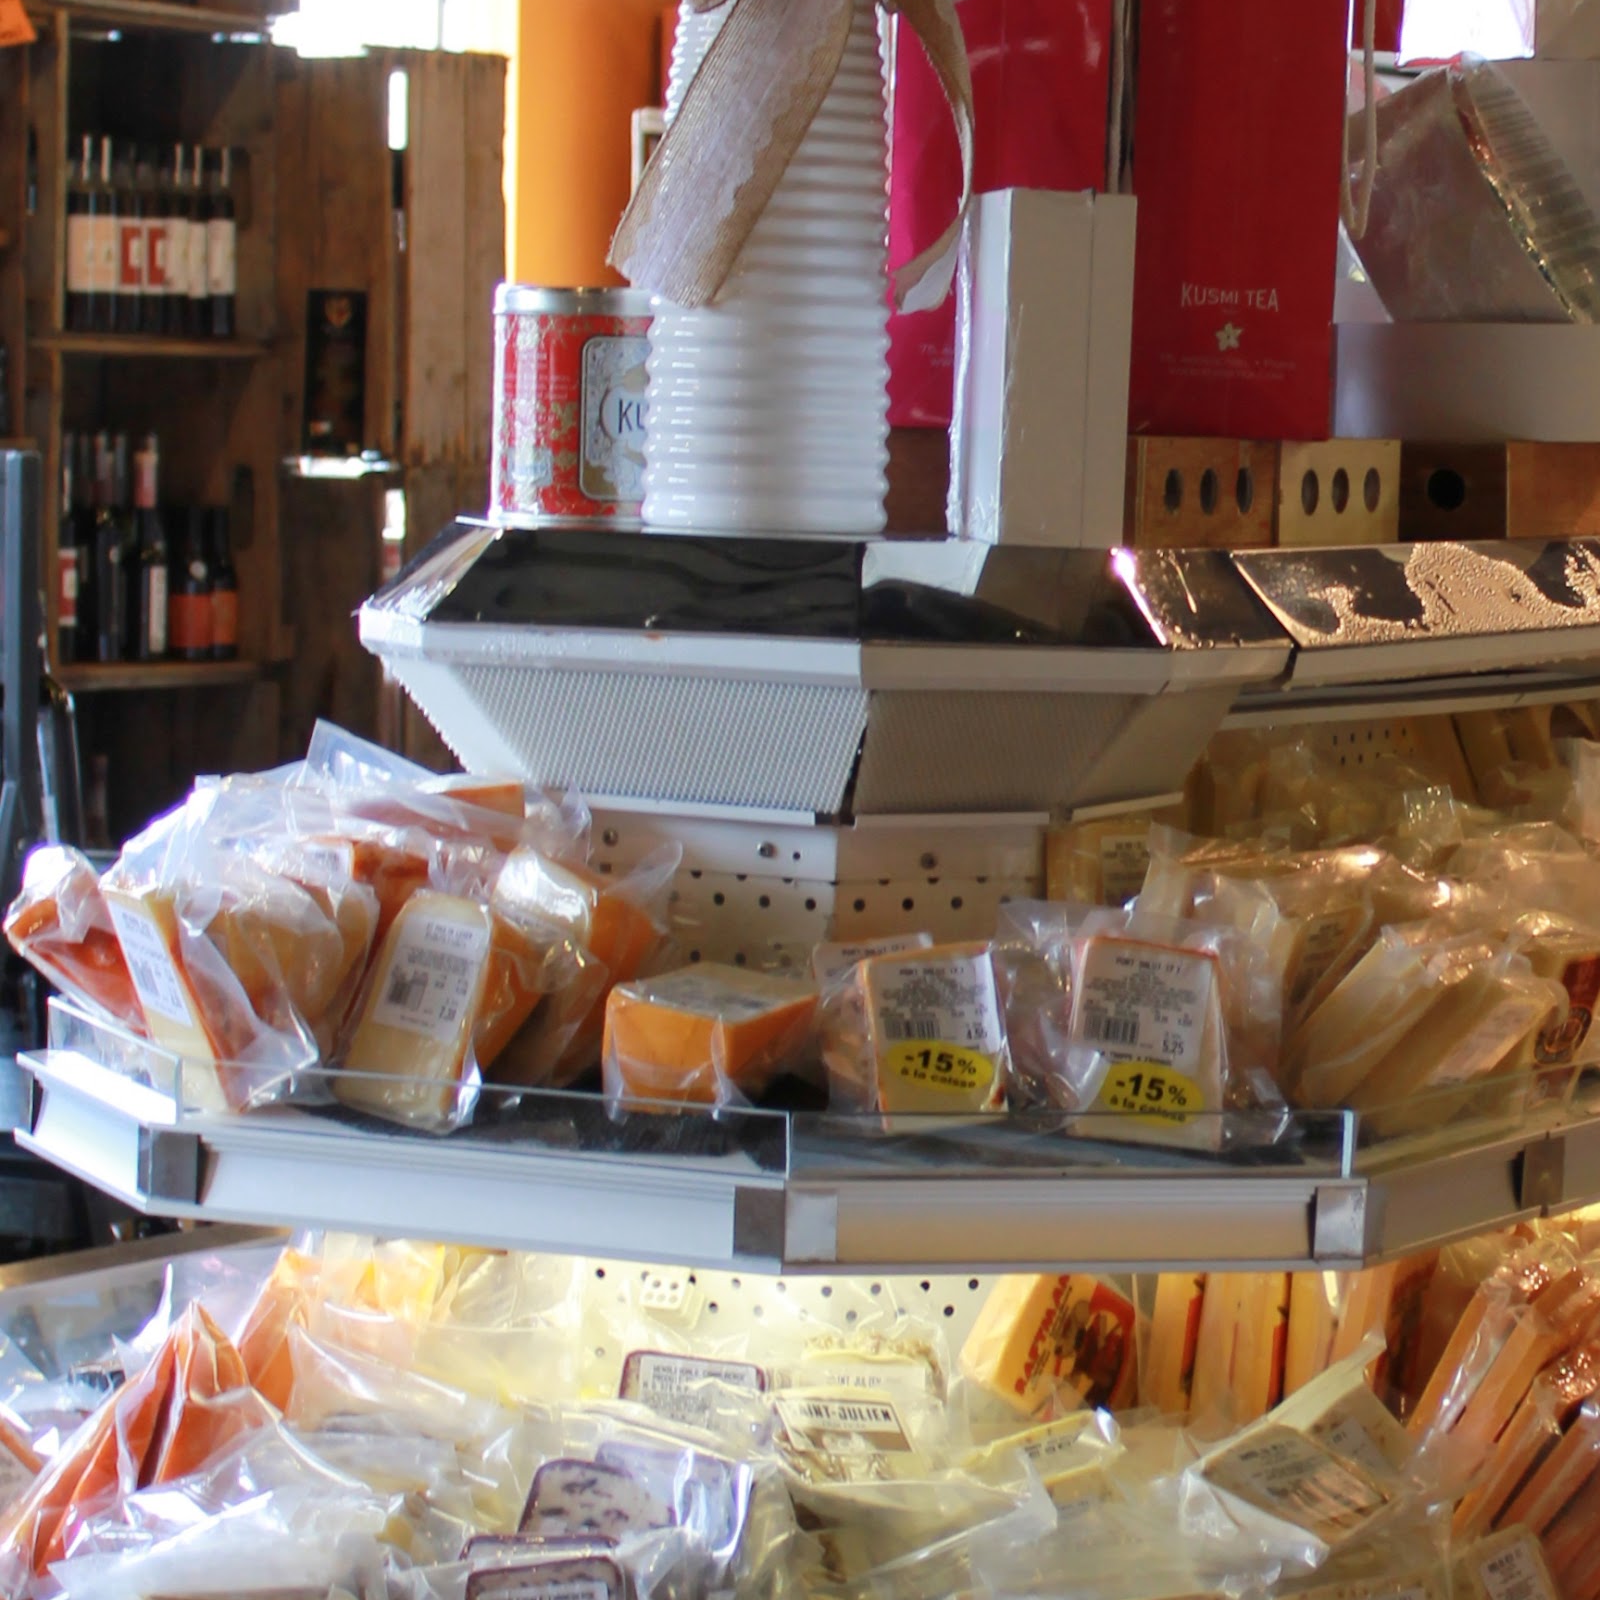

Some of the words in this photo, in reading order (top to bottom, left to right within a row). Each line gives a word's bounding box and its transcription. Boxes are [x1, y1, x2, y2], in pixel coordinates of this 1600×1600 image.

[1180, 282, 1239, 308] KUSMI
[1245, 287, 1280, 313] TEA
[913, 1069, 927, 1080] la
[1122, 1097, 1136, 1110] la
[794, 1401, 893, 1423] AINT-JULIEN
